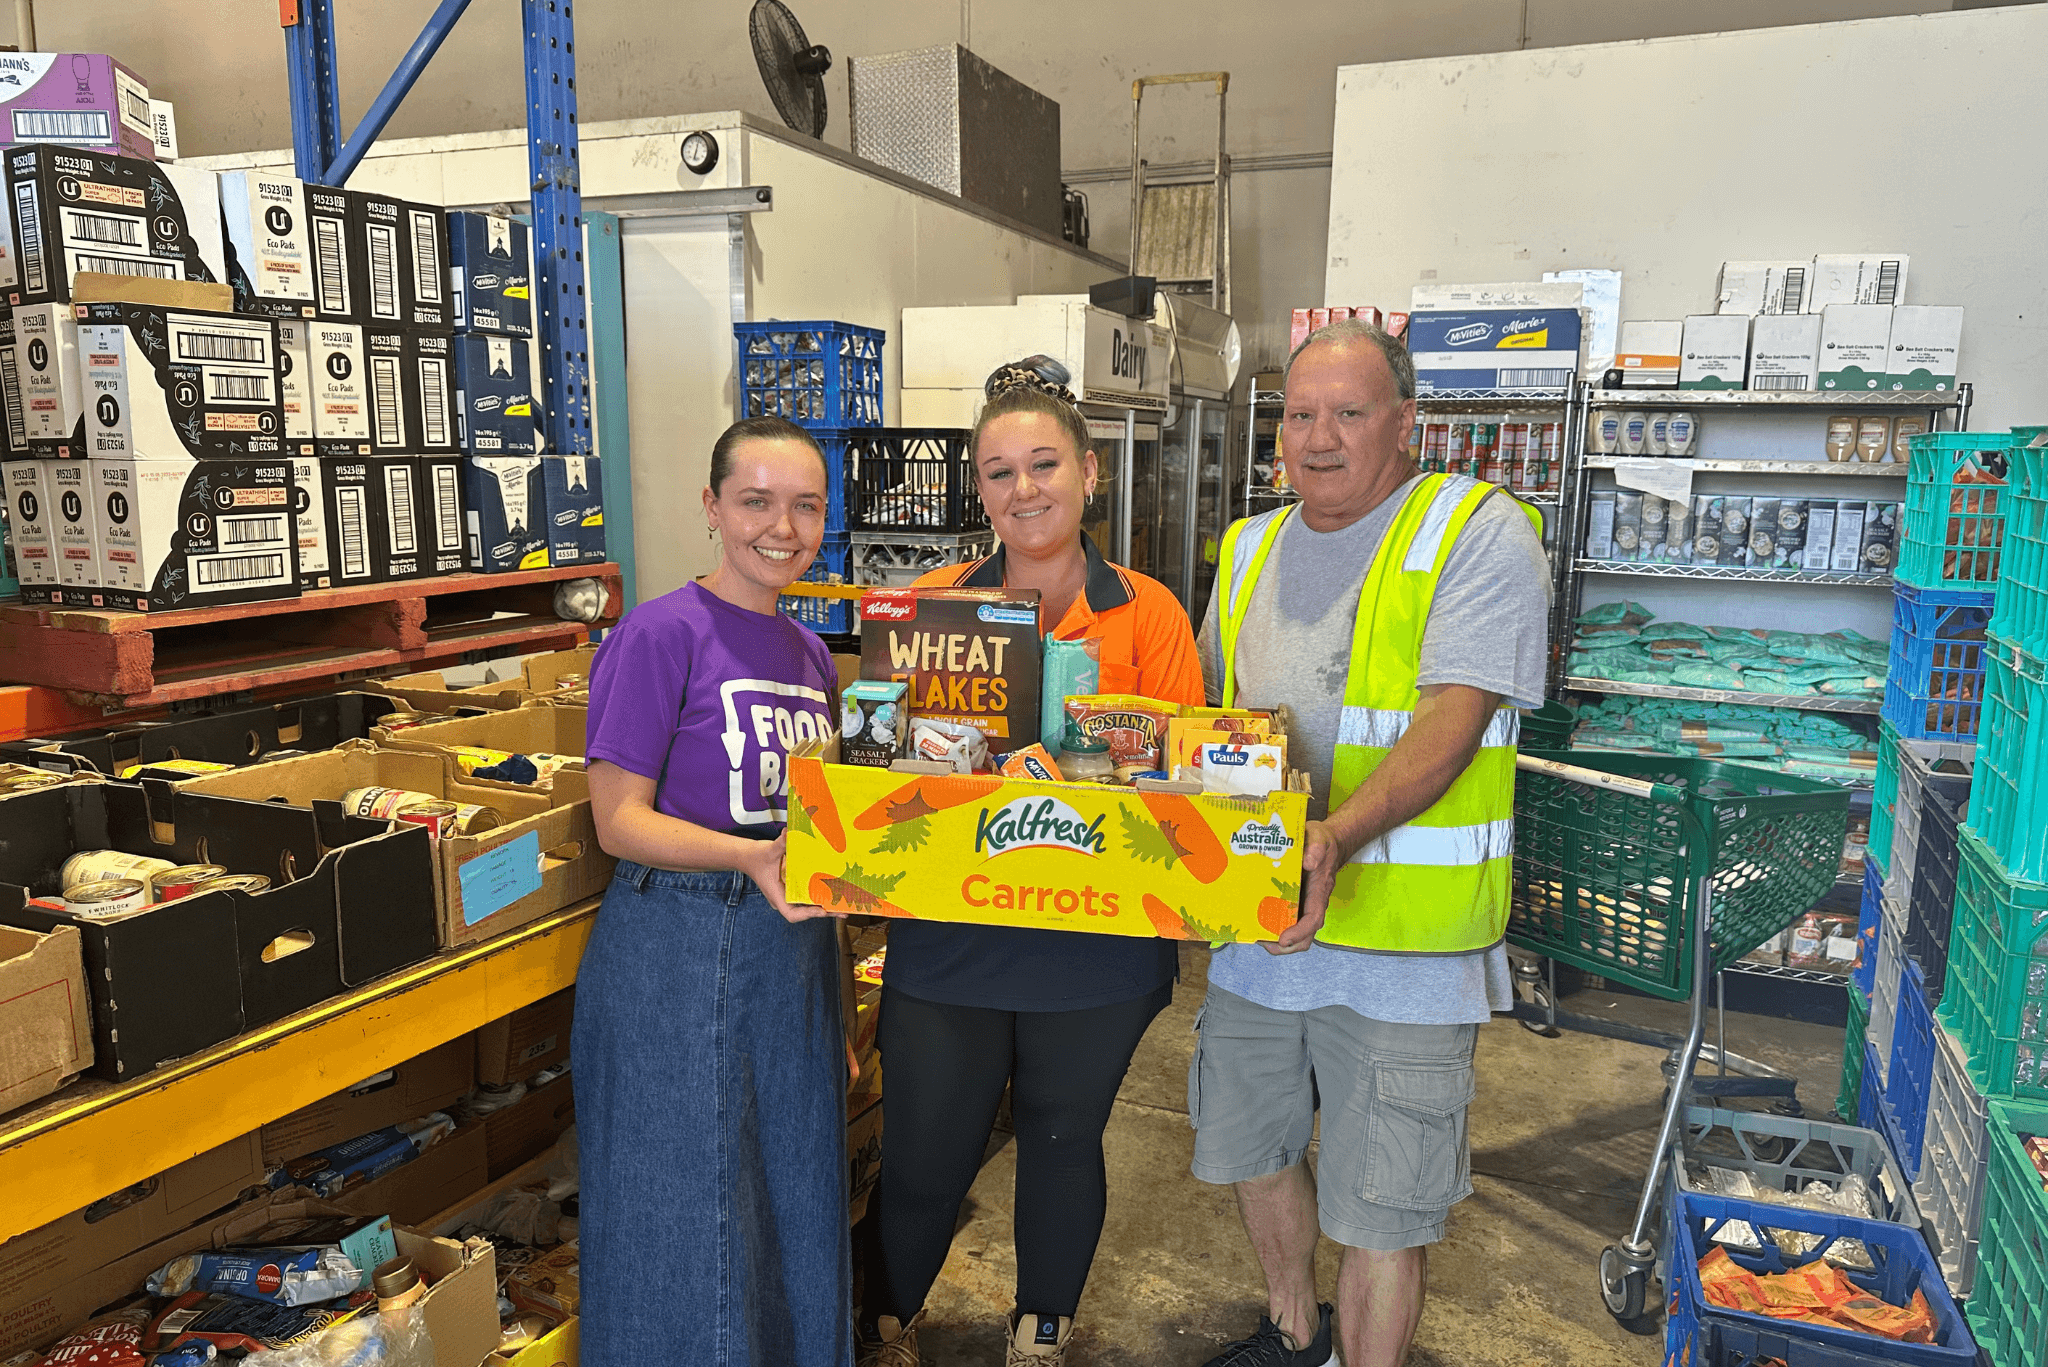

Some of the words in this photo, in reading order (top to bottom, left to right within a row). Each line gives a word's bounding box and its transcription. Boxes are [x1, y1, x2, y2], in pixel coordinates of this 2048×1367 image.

[54, 155, 80, 169] 91523
[80, 158, 94, 171] 01
[84, 183, 121, 194] ULTRATHINS
[259, 183, 280, 195] 91523
[281, 185, 292, 197] 01
[156, 242, 166, 250] Eco
[167, 243, 180, 252] Pads
[267, 239, 279, 248] Eco
[280, 241, 295, 250] Pads
[476, 318, 498, 327] 45581
[1502, 317, 1539, 334] Marie
[282, 328, 293, 339] 01
[322, 332, 342, 342] 91523
[342, 333, 352, 343] 01
[1450, 326, 1487, 343] McVitie's
[1112, 328, 1146, 391] Dairy
[328, 384, 338, 392] Eco
[340, 384, 353, 392] Pads
[478, 439, 499, 447] 45581
[102, 469, 120, 480] 91523
[120, 469, 129, 481] 01
[256, 468, 275, 477] 91523
[276, 467, 286, 478] 01
[301, 466, 310, 476] 01
[336, 466, 355, 475] 91523
[356, 465, 366, 475] 01
[110, 527, 118, 536] Eco
[120, 528, 131, 537] Pads
[867, 602, 912, 618] Kellogg's
[889, 630, 1011, 675] WHEAT
[750, 704, 834, 750] FOOD
[961, 718, 988, 727] GRAIN
[1083, 713, 1159, 749] COSTANZA
[848, 757, 889, 766] CRACKERS
[1213, 753, 1244, 763] Pauls
[975, 799, 1106, 853] Kalfresh
[1247, 824, 1280, 834] Proudly
[1231, 832, 1294, 847] Australian
[961, 874, 1120, 917] Carrots
[94, 903, 129, 912] WHITLOCK
[528, 1042, 546, 1058] 235
[338, 1133, 381, 1155] ORIGINAL
[3, 1297, 52, 1324] POULTRY
[14, 1313, 63, 1340] POULTRY
